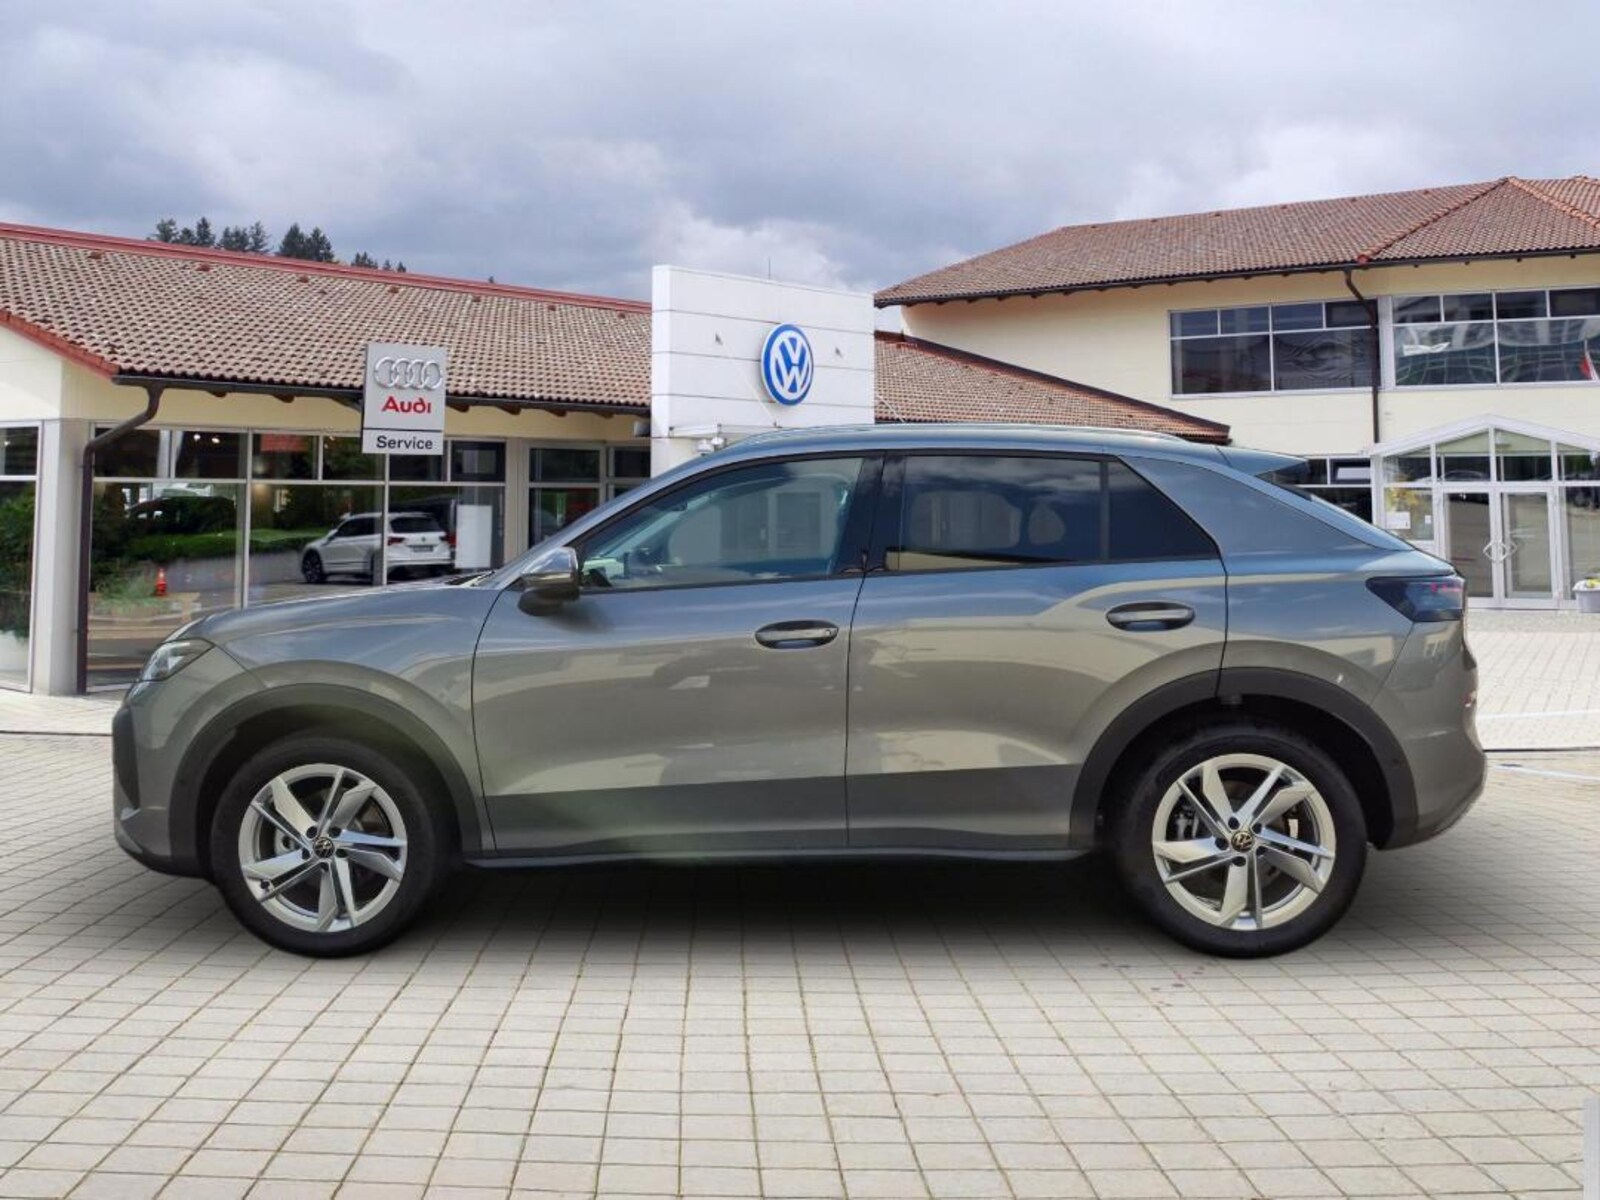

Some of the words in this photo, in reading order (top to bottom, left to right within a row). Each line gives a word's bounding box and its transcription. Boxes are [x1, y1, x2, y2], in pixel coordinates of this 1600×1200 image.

[768, 330, 811, 399] VW
[381, 396, 432, 414] Audi
[376, 435, 433, 450] Service
